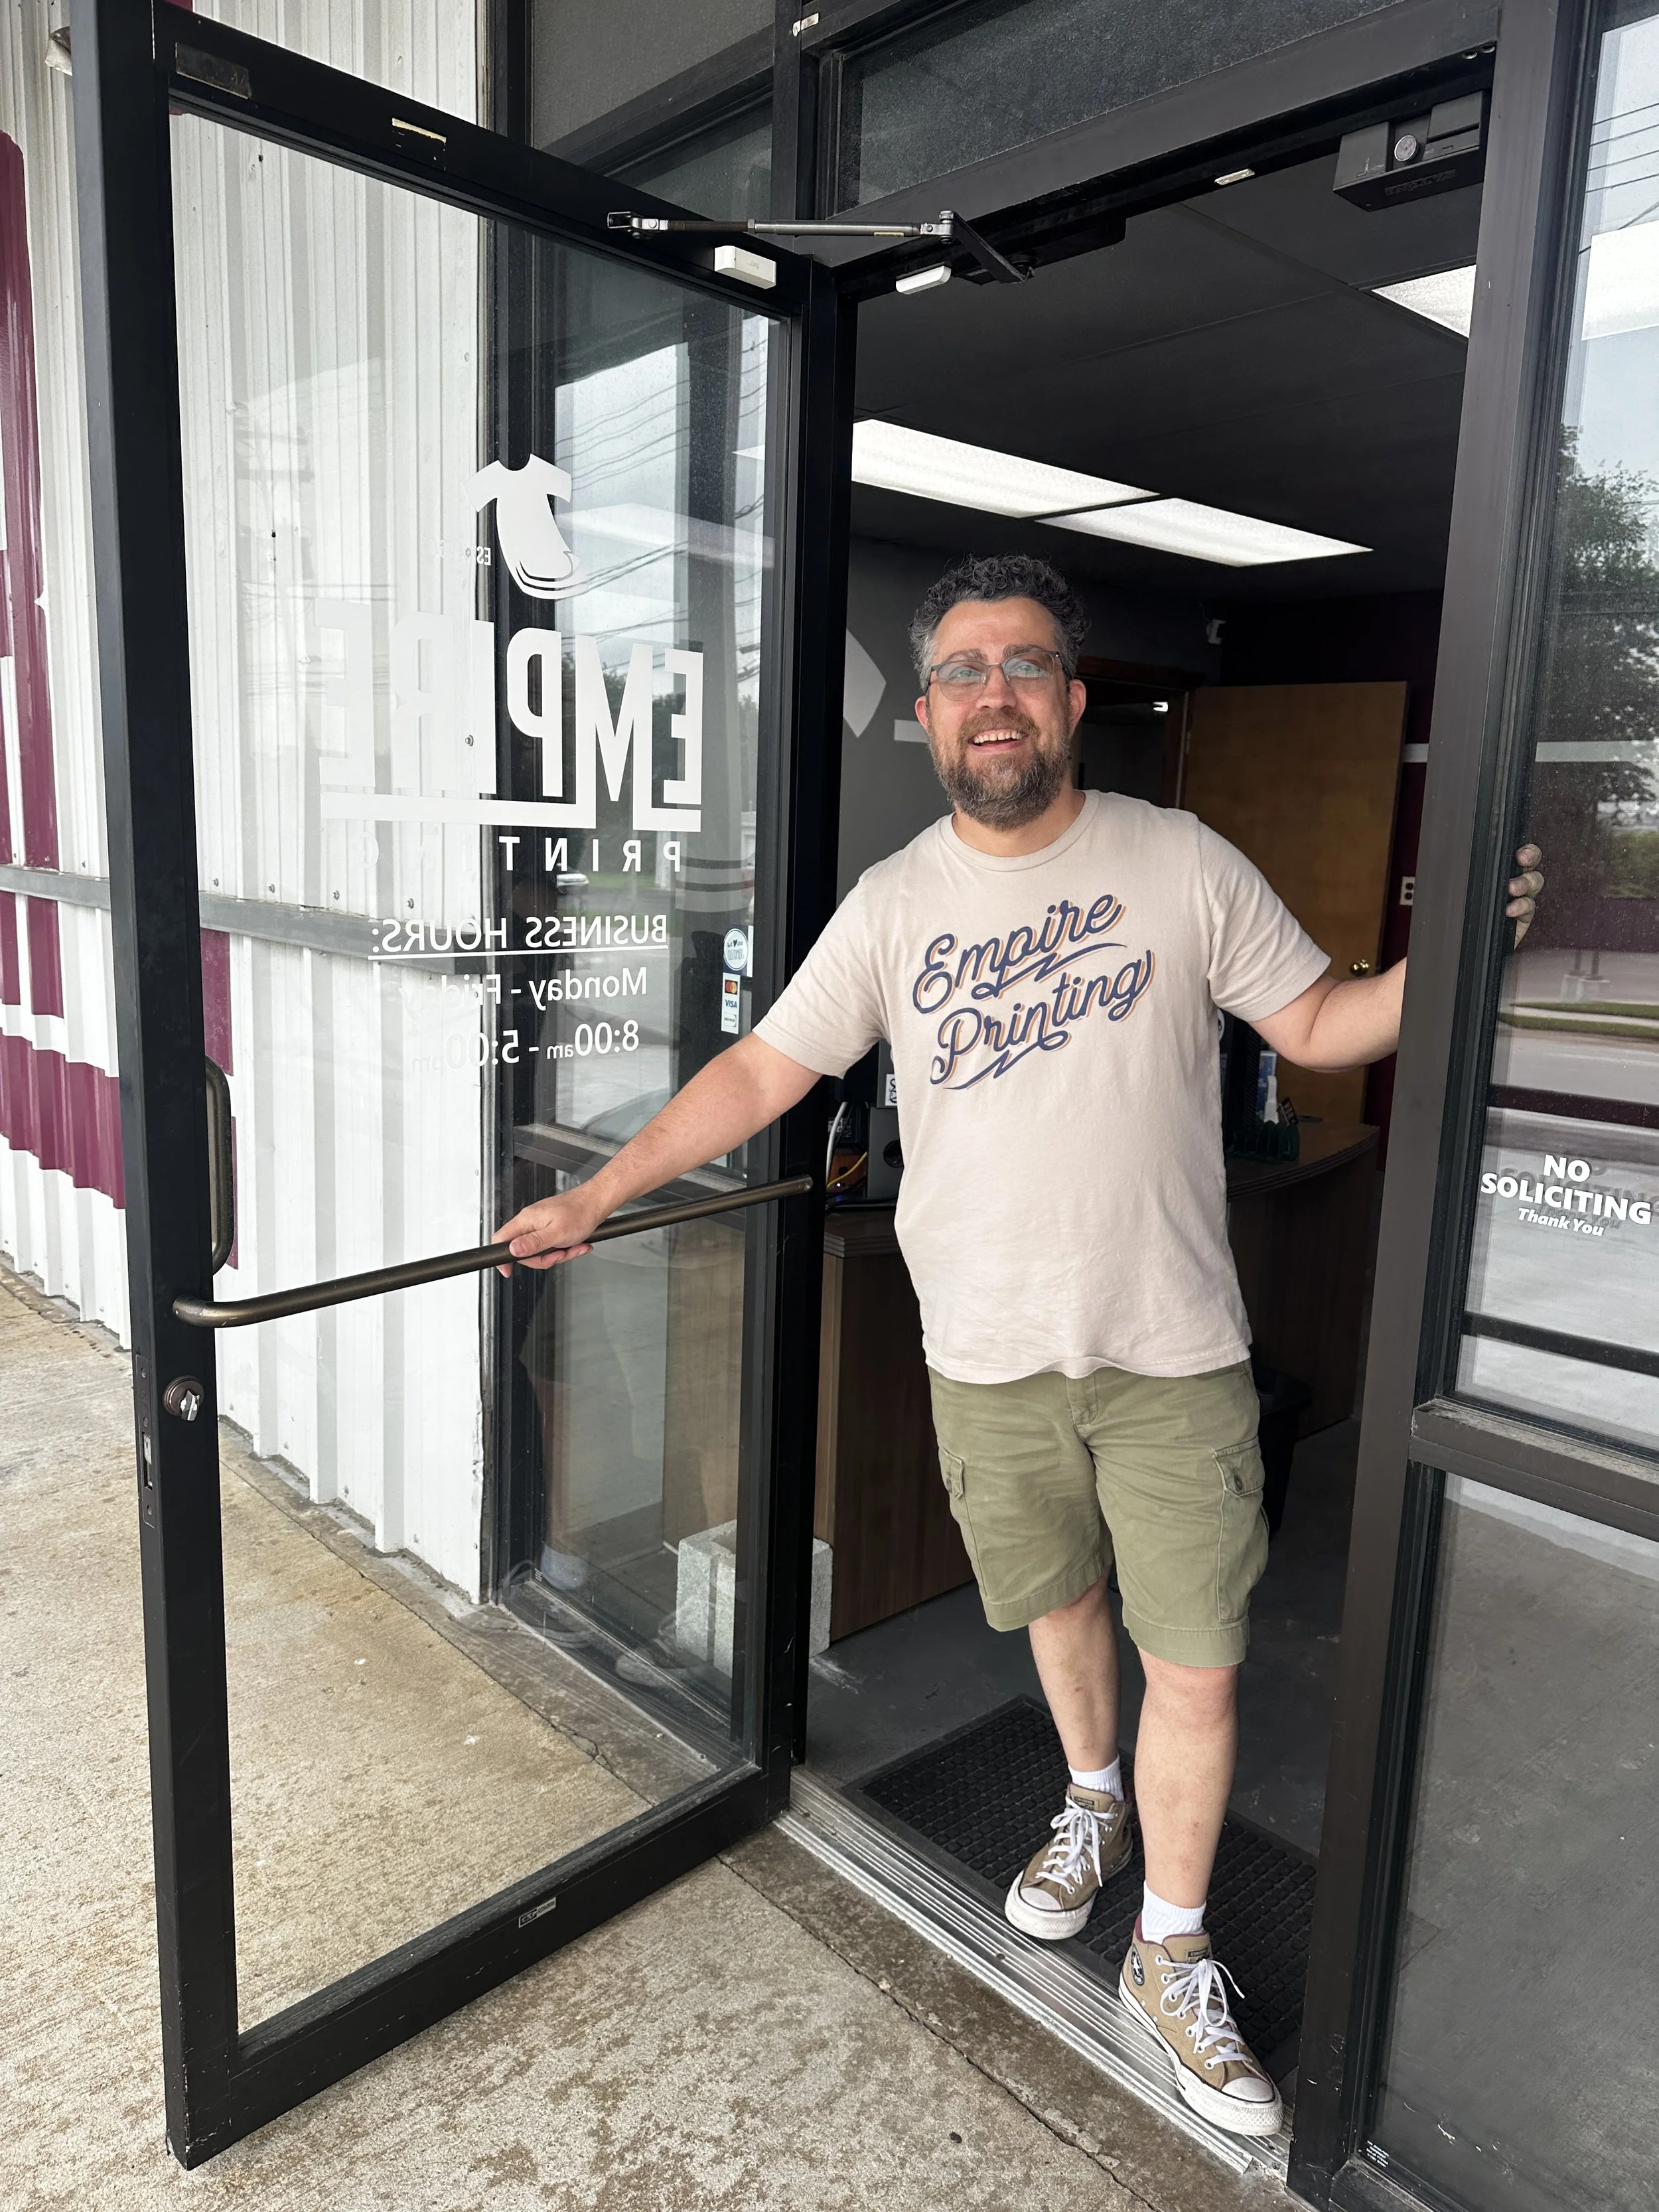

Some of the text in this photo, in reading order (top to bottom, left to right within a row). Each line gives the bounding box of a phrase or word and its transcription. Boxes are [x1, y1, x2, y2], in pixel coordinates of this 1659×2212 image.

[912, 894, 1127, 1013] Empire
[725, 999, 737, 1008] VISA
[930, 950, 1155, 1090] Printing
[1543, 1154, 1590, 1183] NO
[1480, 1172, 1651, 1224] SOLICITING
[1518, 1207, 1605, 1237] Thank You
